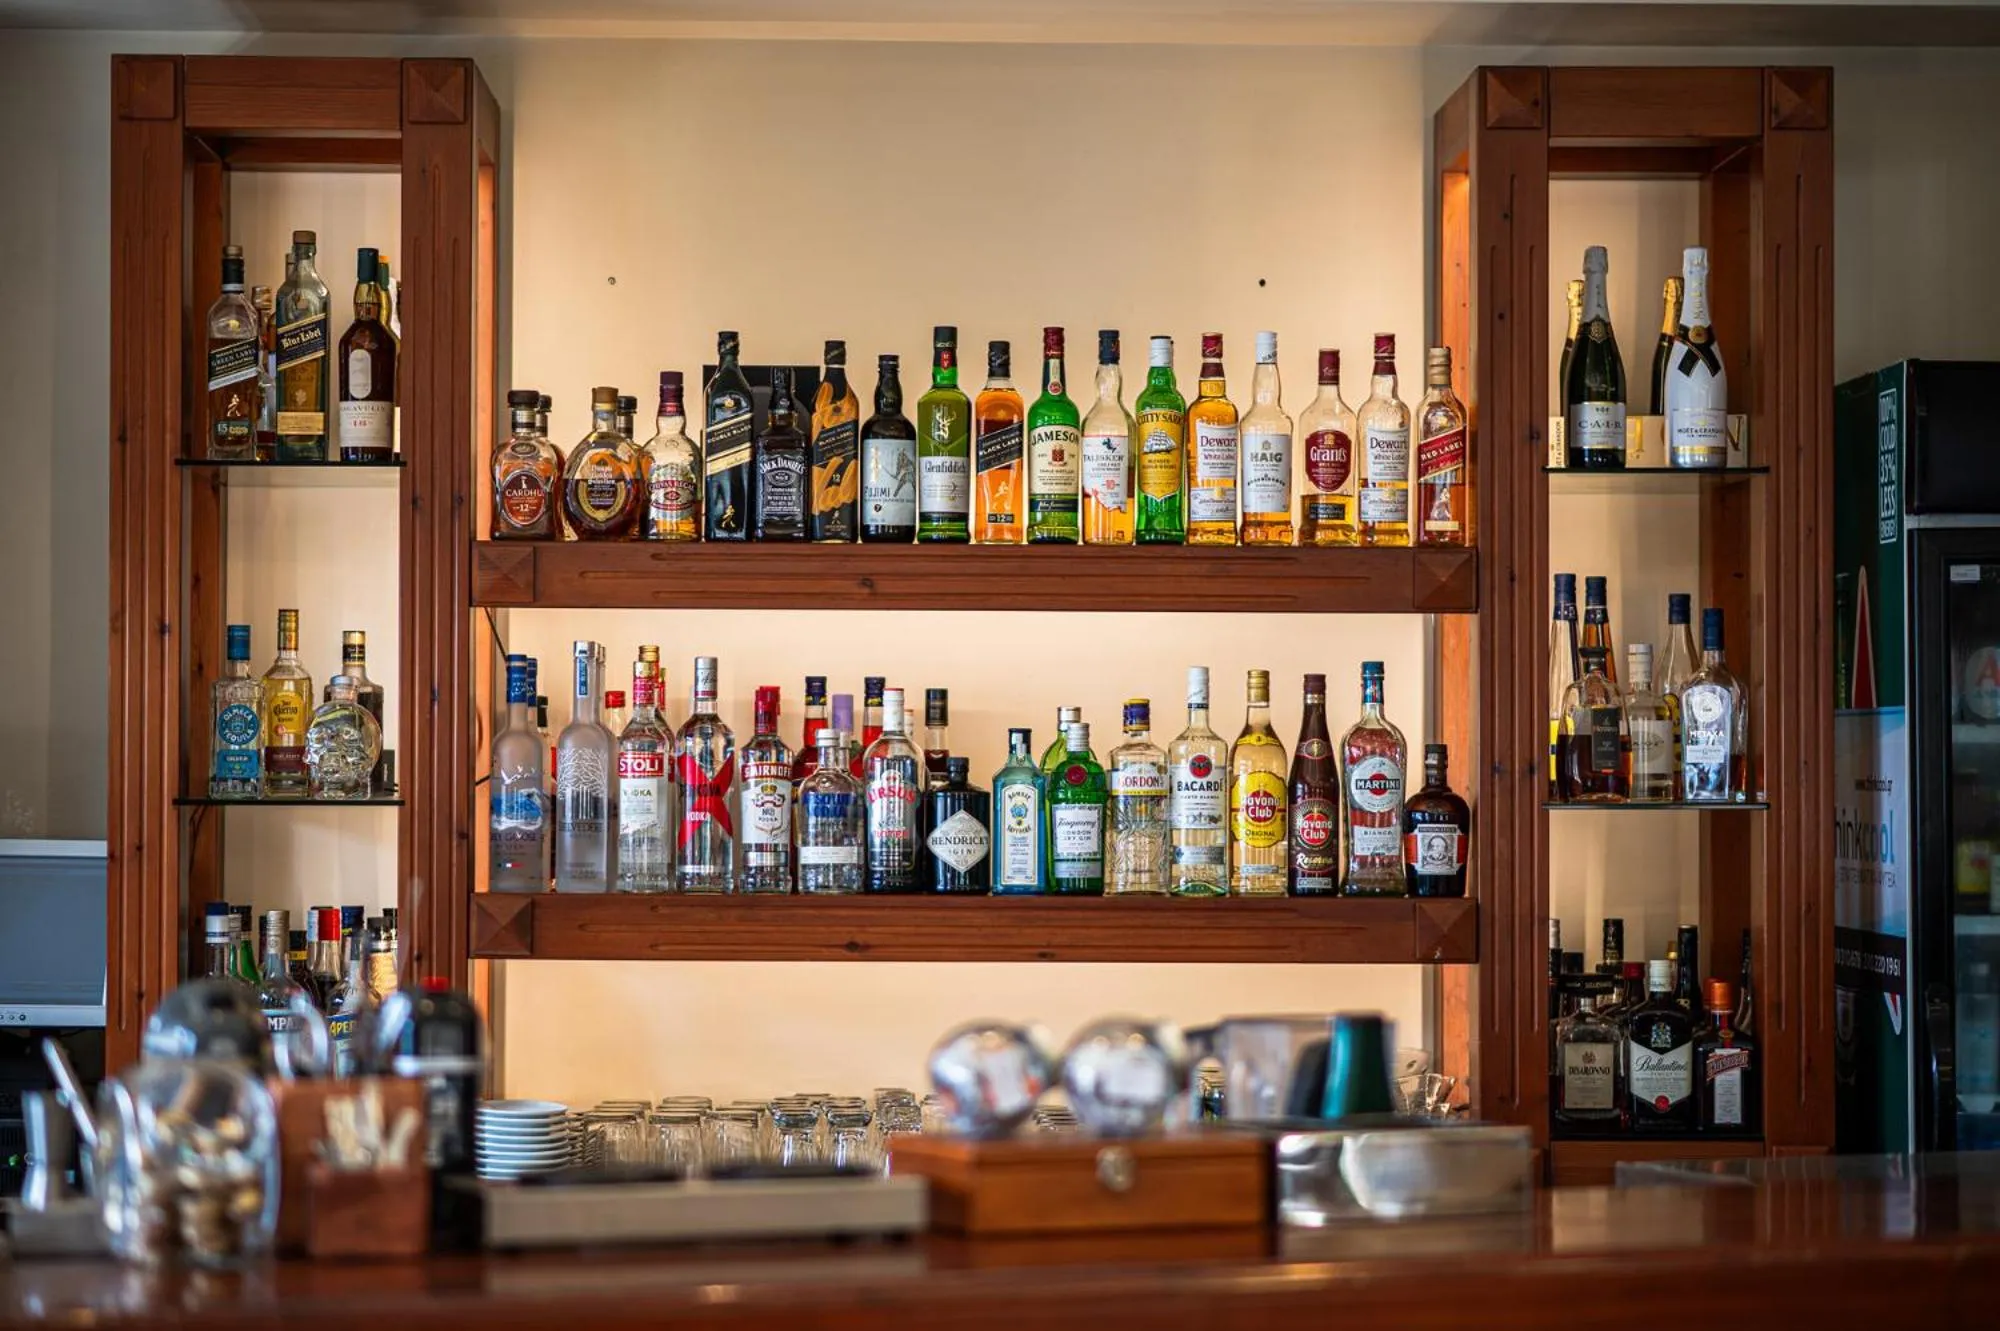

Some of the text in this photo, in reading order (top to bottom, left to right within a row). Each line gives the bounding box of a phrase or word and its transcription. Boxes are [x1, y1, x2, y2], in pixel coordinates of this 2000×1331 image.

[300, 327, 322, 344] Label
[1250, 452, 1283, 463] HAIG
[1421, 449, 1438, 461] RED
[1438, 441, 1464, 455] LABEL
[760, 459, 778, 474] JACK
[620, 757, 660, 773] STOLI
[744, 764, 792, 778] SMIRNOFF
[1356, 779, 1400, 790] MARTINI
[867, 785, 917, 804] URSUS
[1247, 806, 1273, 818] Club
[1304, 828, 1326, 841] Club
[1835, 806, 1895, 865] hinkcool
[1569, 1066, 1611, 1076] DISARONNO
